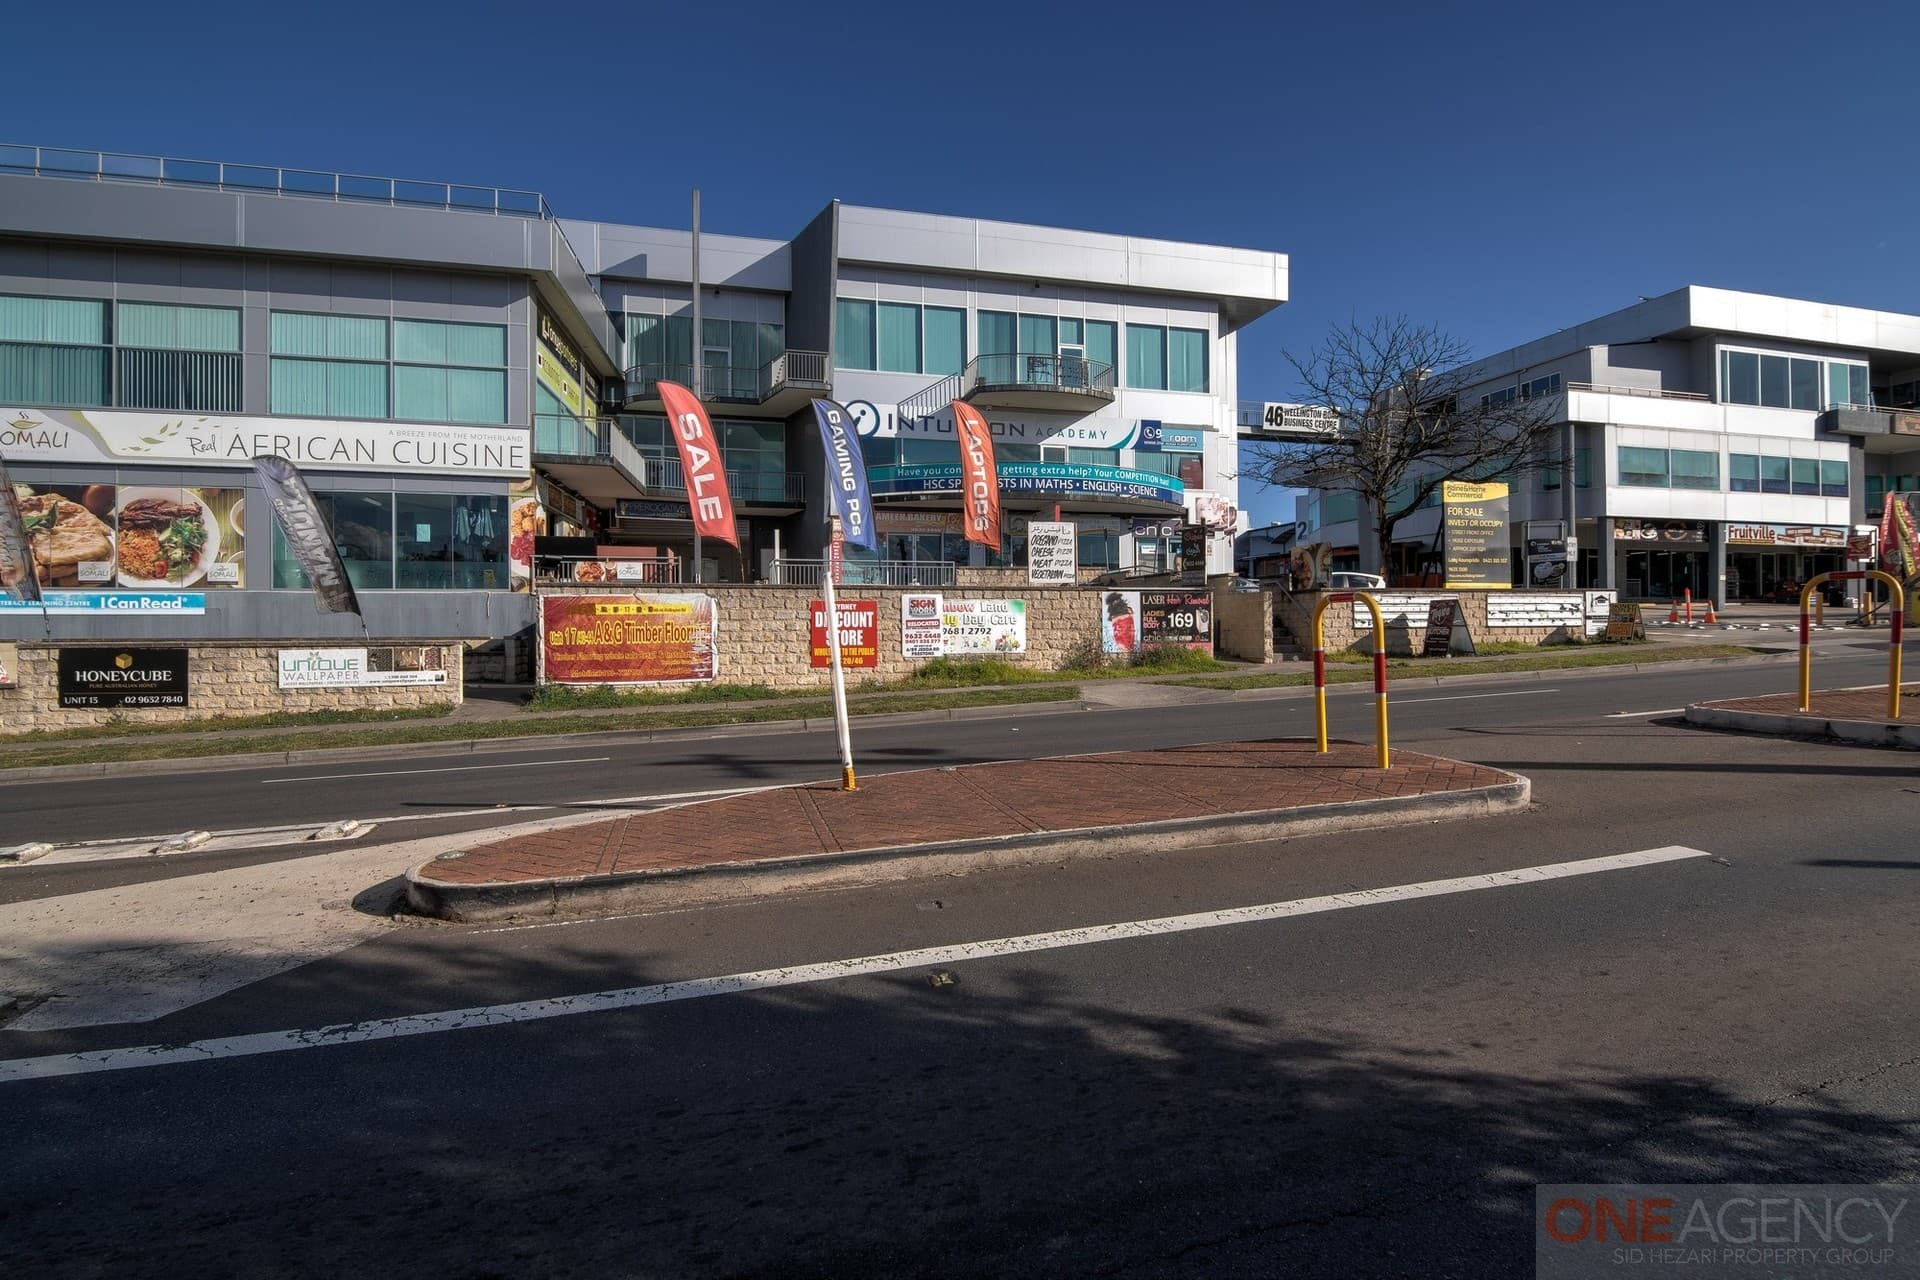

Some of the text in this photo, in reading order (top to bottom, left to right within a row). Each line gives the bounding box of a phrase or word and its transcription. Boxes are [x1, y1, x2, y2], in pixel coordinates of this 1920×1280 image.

[1265, 406, 1284, 427] 46
[888, 414, 1107, 440] INTUON ACADEMY
[227, 434, 524, 468] AFRICAN CUISINE
[828, 410, 856, 491] GAMING
[679, 413, 723, 522] SALE
[897, 467, 921, 476] Have
[923, 469, 941, 477] you
[1003, 465, 1038, 475] getting
[1041, 466, 1065, 475] extra
[1069, 466, 1091, 477] help?
[1094, 470, 1113, 478] Your
[1115, 470, 1159, 484] COMPETITION
[923, 480, 945, 489] HSC
[1020, 478, 1032, 488] IN
[1035, 478, 1073, 489] MATHS
[1083, 481, 1158, 497] ENGLISH SCIENCE
[1447, 507, 1484, 517] FOR SALE
[1728, 524, 1776, 540] Fruitville
[1032, 558, 1054, 568] MEAT
[910, 599, 935, 608] SIGN
[1142, 595, 1165, 604] LASER
[980, 602, 1008, 613] Land
[815, 611, 874, 628] DICOUNT
[963, 614, 985, 626] Day
[991, 615, 1017, 625] Care
[1168, 613, 1194, 628] 169
[624, 620, 663, 644] Timber
[75, 670, 172, 682] HONEYCUBE
[283, 670, 360, 681] WALLPAPER
[64, 696, 87, 704] UNIT
[124, 696, 137, 704] 02
[160, 695, 183, 704] 7840
